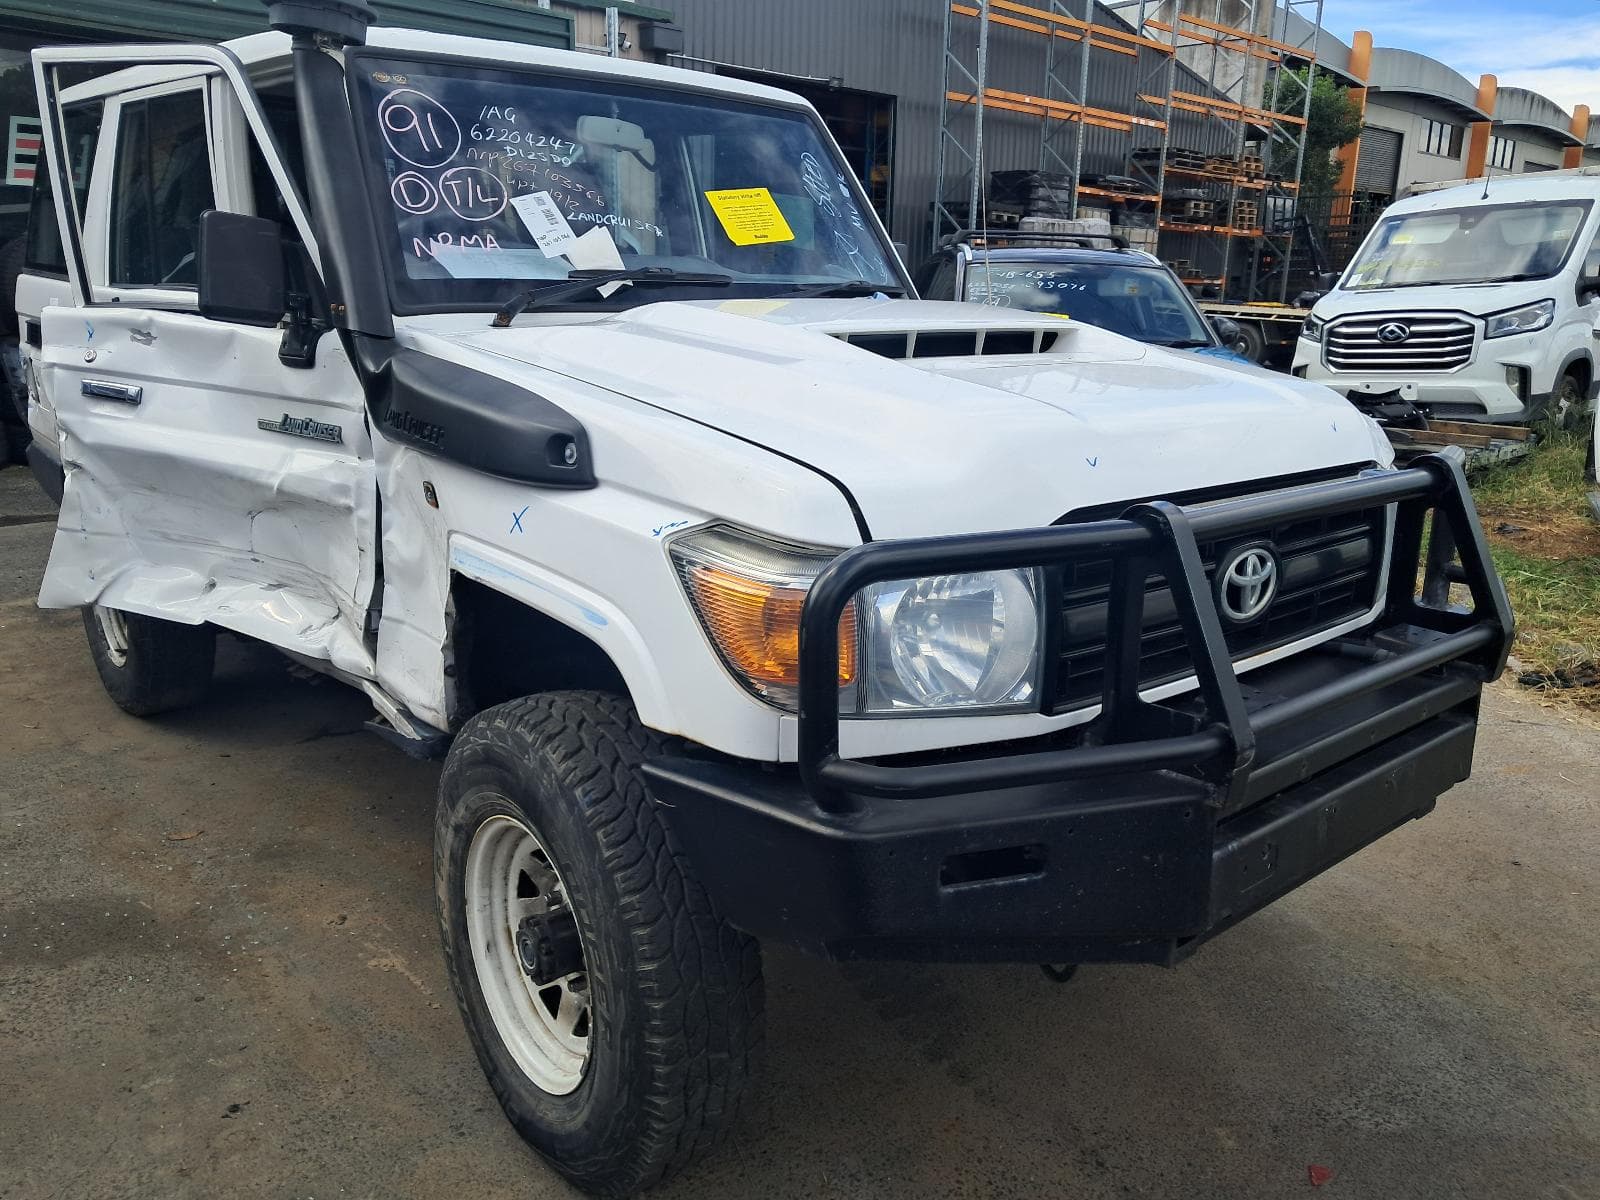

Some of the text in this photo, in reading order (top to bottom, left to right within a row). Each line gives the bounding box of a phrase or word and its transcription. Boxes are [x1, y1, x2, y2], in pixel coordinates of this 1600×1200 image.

[384, 104, 443, 152] 91
[470, 123, 576, 155] 62204247
[399, 177, 430, 208] D
